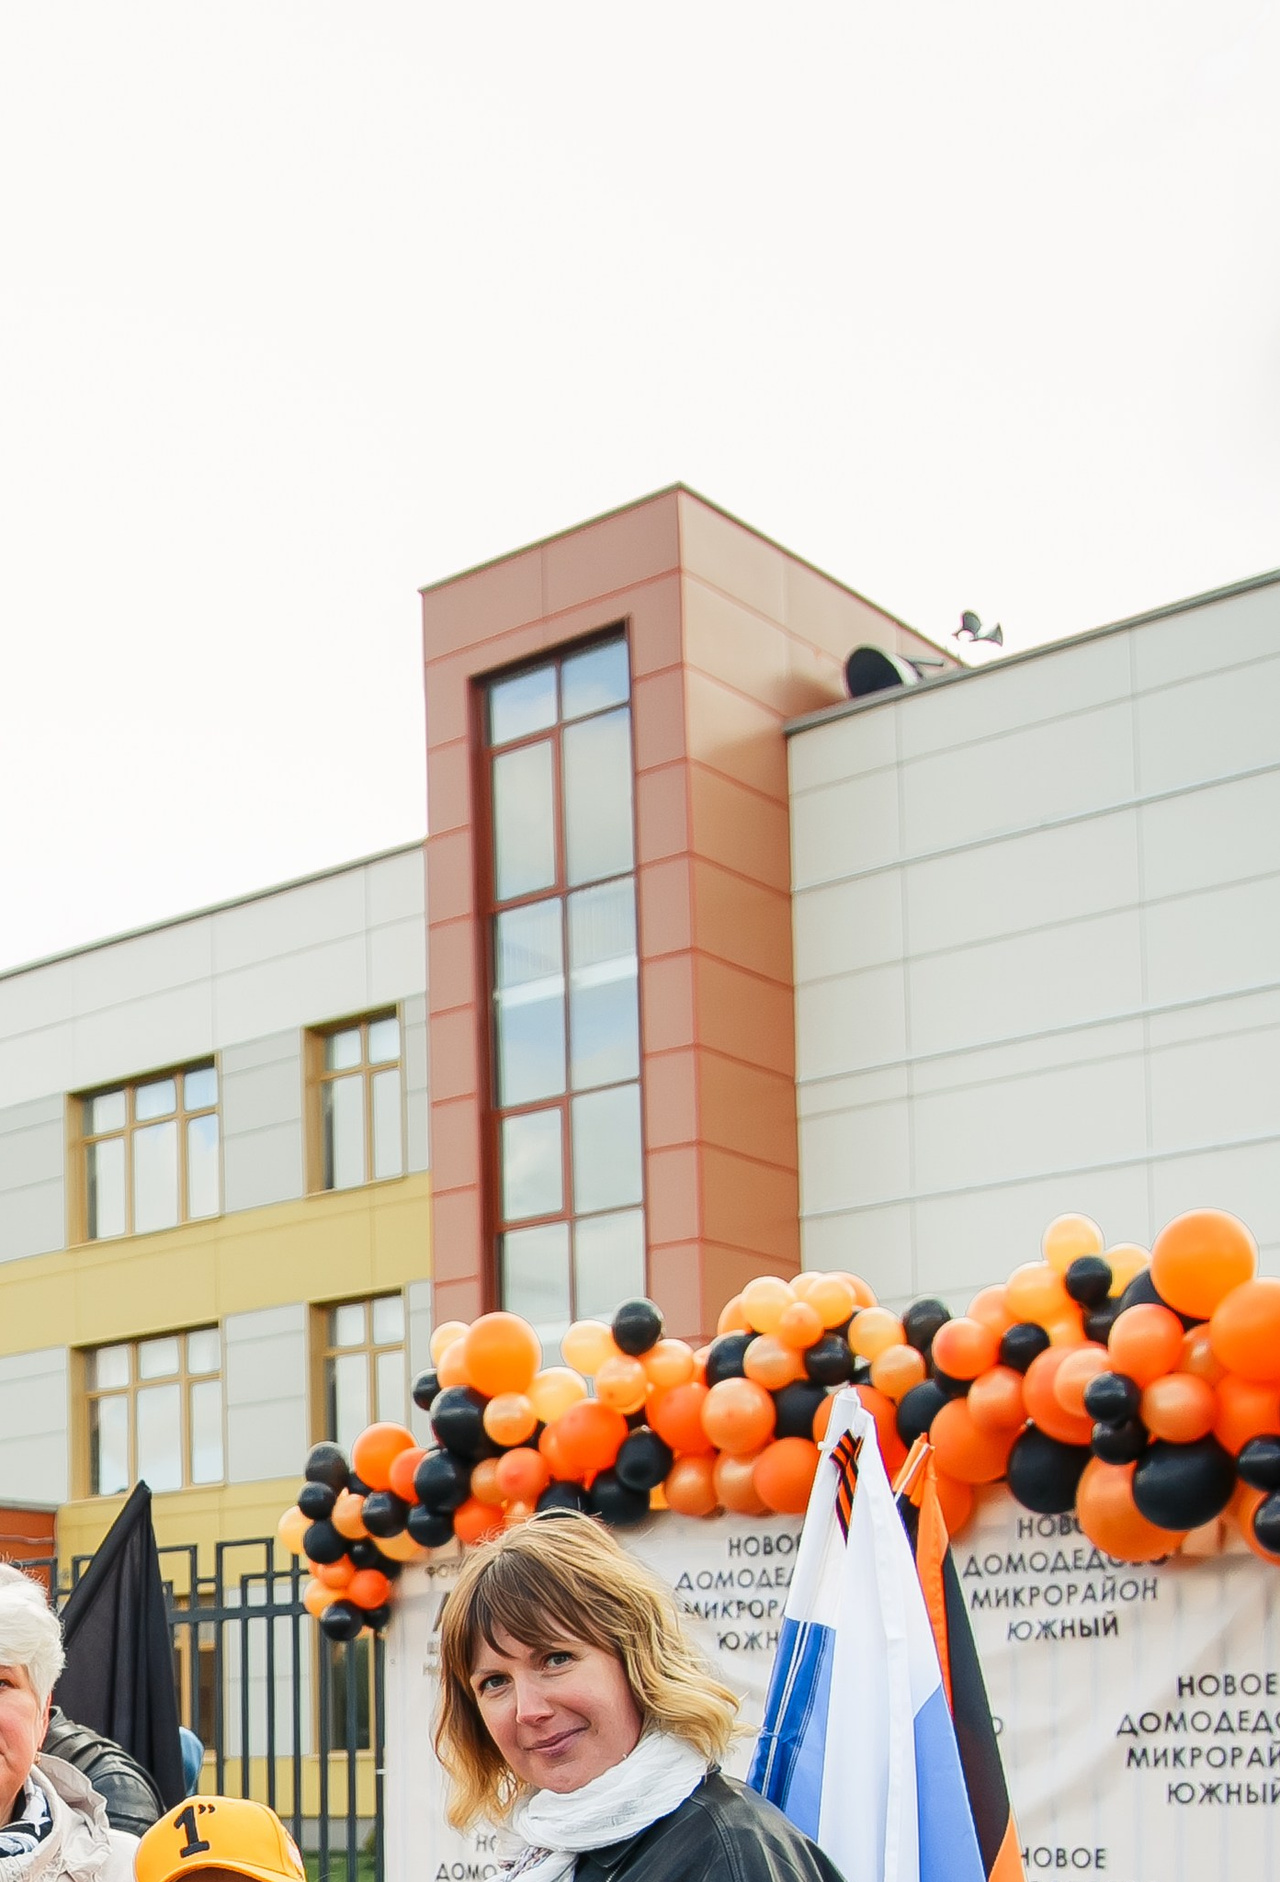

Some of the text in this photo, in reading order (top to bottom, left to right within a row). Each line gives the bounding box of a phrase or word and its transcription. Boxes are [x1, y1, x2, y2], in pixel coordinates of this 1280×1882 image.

[1017, 1515, 1085, 1539] НОВ
[963, 1549, 1170, 1578] ДОМОДЕД
[674, 1567, 794, 1591] ДОМОДЕ
[970, 1575, 1159, 1610] МИКРОРАЙОН
[683, 1600, 787, 1619] МИКРОР
[1007, 1611, 1120, 1641] ЮЖНЫЙ
[717, 1631, 779, 1651] ЮЖН
[1177, 1673, 1277, 1698] НОВОЕ
[1116, 1709, 1280, 1737] ДОМОДЕД
[1127, 1740, 1280, 1769] МИКРОРАЙ
